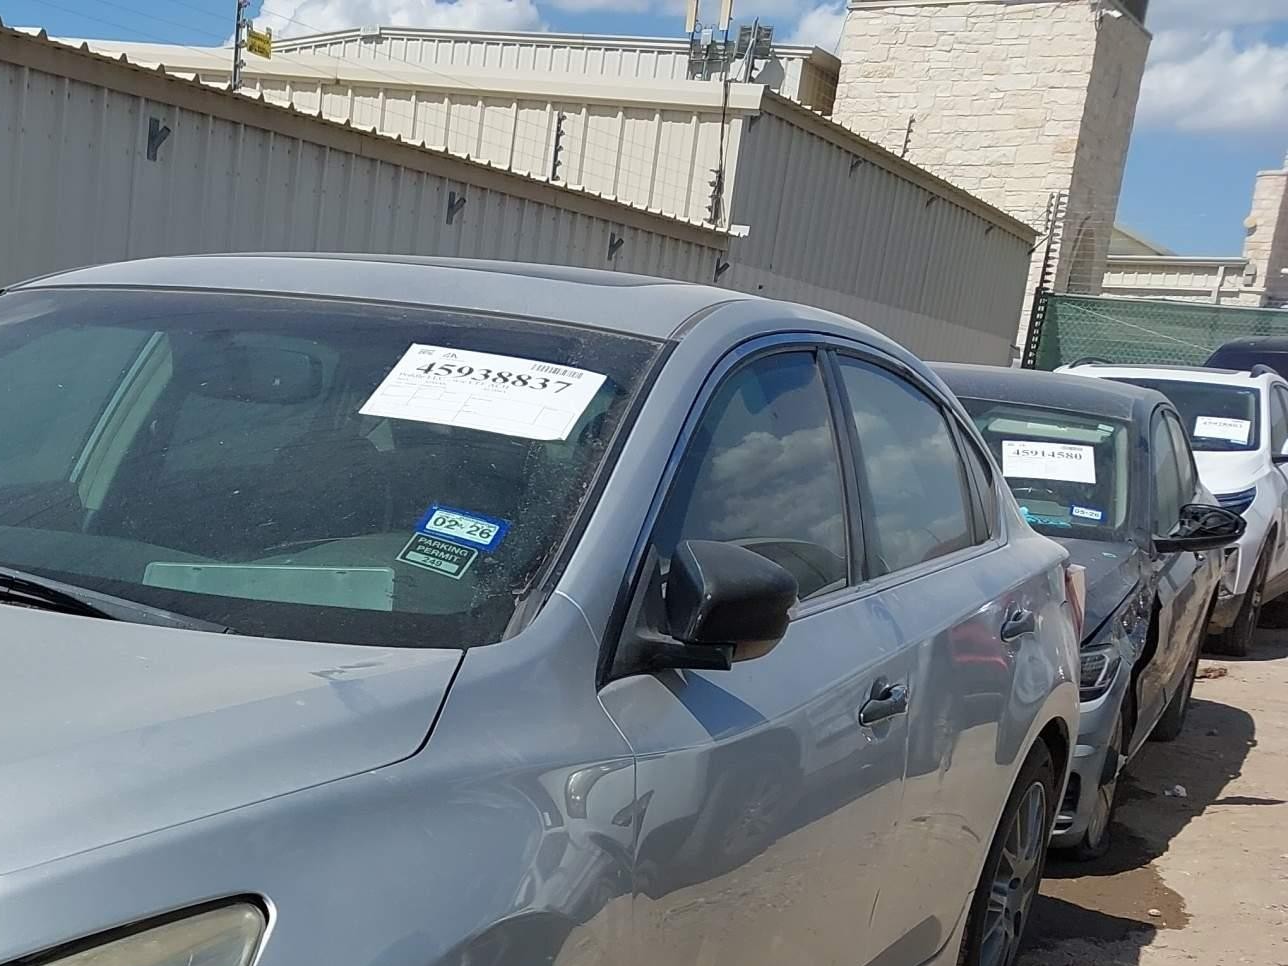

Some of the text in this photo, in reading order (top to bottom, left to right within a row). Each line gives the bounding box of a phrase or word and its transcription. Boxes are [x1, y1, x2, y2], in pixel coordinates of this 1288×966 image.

[416, 362, 572, 394] 45938837
[1013, 448, 1082, 460] 45914580
[416, 545, 462, 562] PERMIT
[417, 537, 469, 557] PARKING
